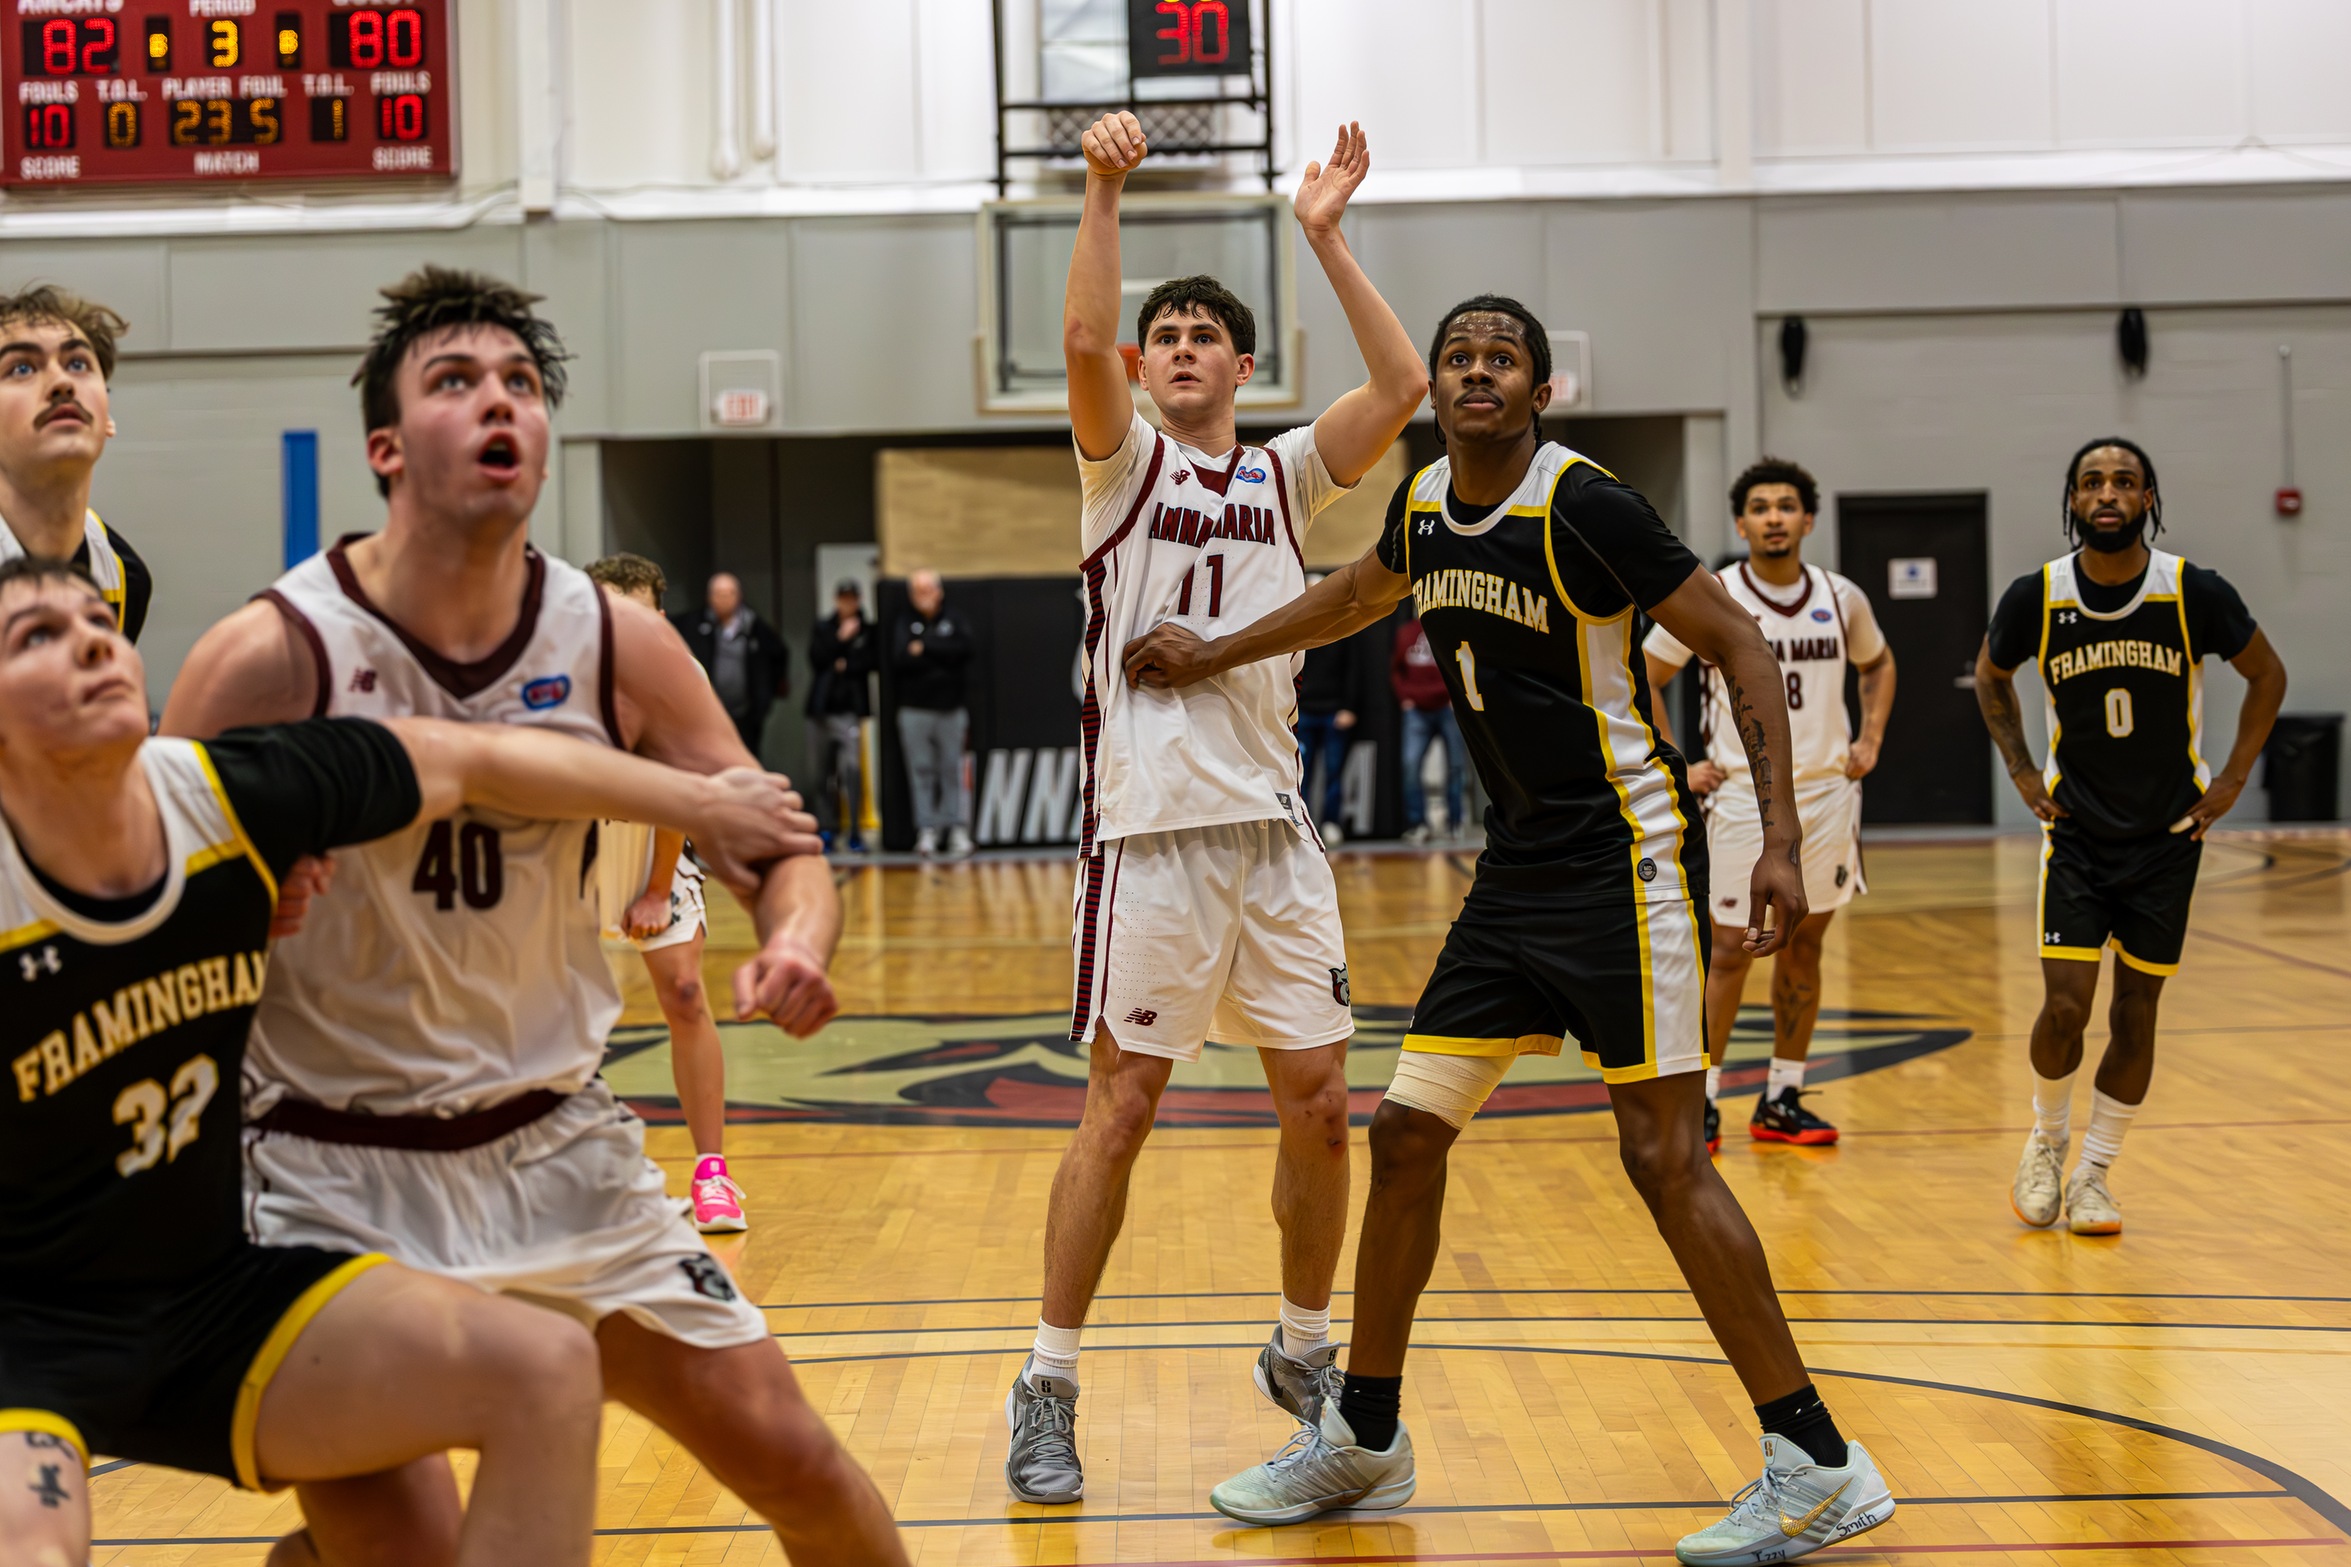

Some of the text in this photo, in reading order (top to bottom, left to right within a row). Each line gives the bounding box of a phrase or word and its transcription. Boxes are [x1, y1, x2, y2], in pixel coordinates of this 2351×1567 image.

[43, 18, 116, 75] 82
[212, 20, 239, 67] 3
[348, 10, 422, 69] 80
[1155, 0, 1229, 65] 30
[19, 80, 79, 104] FOULS
[162, 75, 288, 100] PLAYER FOUL
[370, 71, 432, 96] FOULS
[30, 104, 70, 147] 10
[107, 101, 137, 147] 0
[174, 97, 279, 146] 23 5
[332, 99, 343, 139] 1
[382, 94, 423, 141] 10
[20, 156, 81, 180] SCORE
[193, 150, 260, 175] MATCH
[372, 146, 433, 171] SCORE
[1148, 502, 1214, 548] ANNA
[1177, 554, 1224, 618] 11
[1791, 637, 1839, 662] MARIA
[2049, 639, 2182, 686] FRAMINGHAM
[1456, 641, 1485, 711] 1
[1786, 672, 1803, 710] 8
[2104, 687, 2135, 739] 0
[411, 818, 503, 912] 40
[112, 1053, 220, 1178] 32
[1835, 1512, 1878, 1538] Smith
